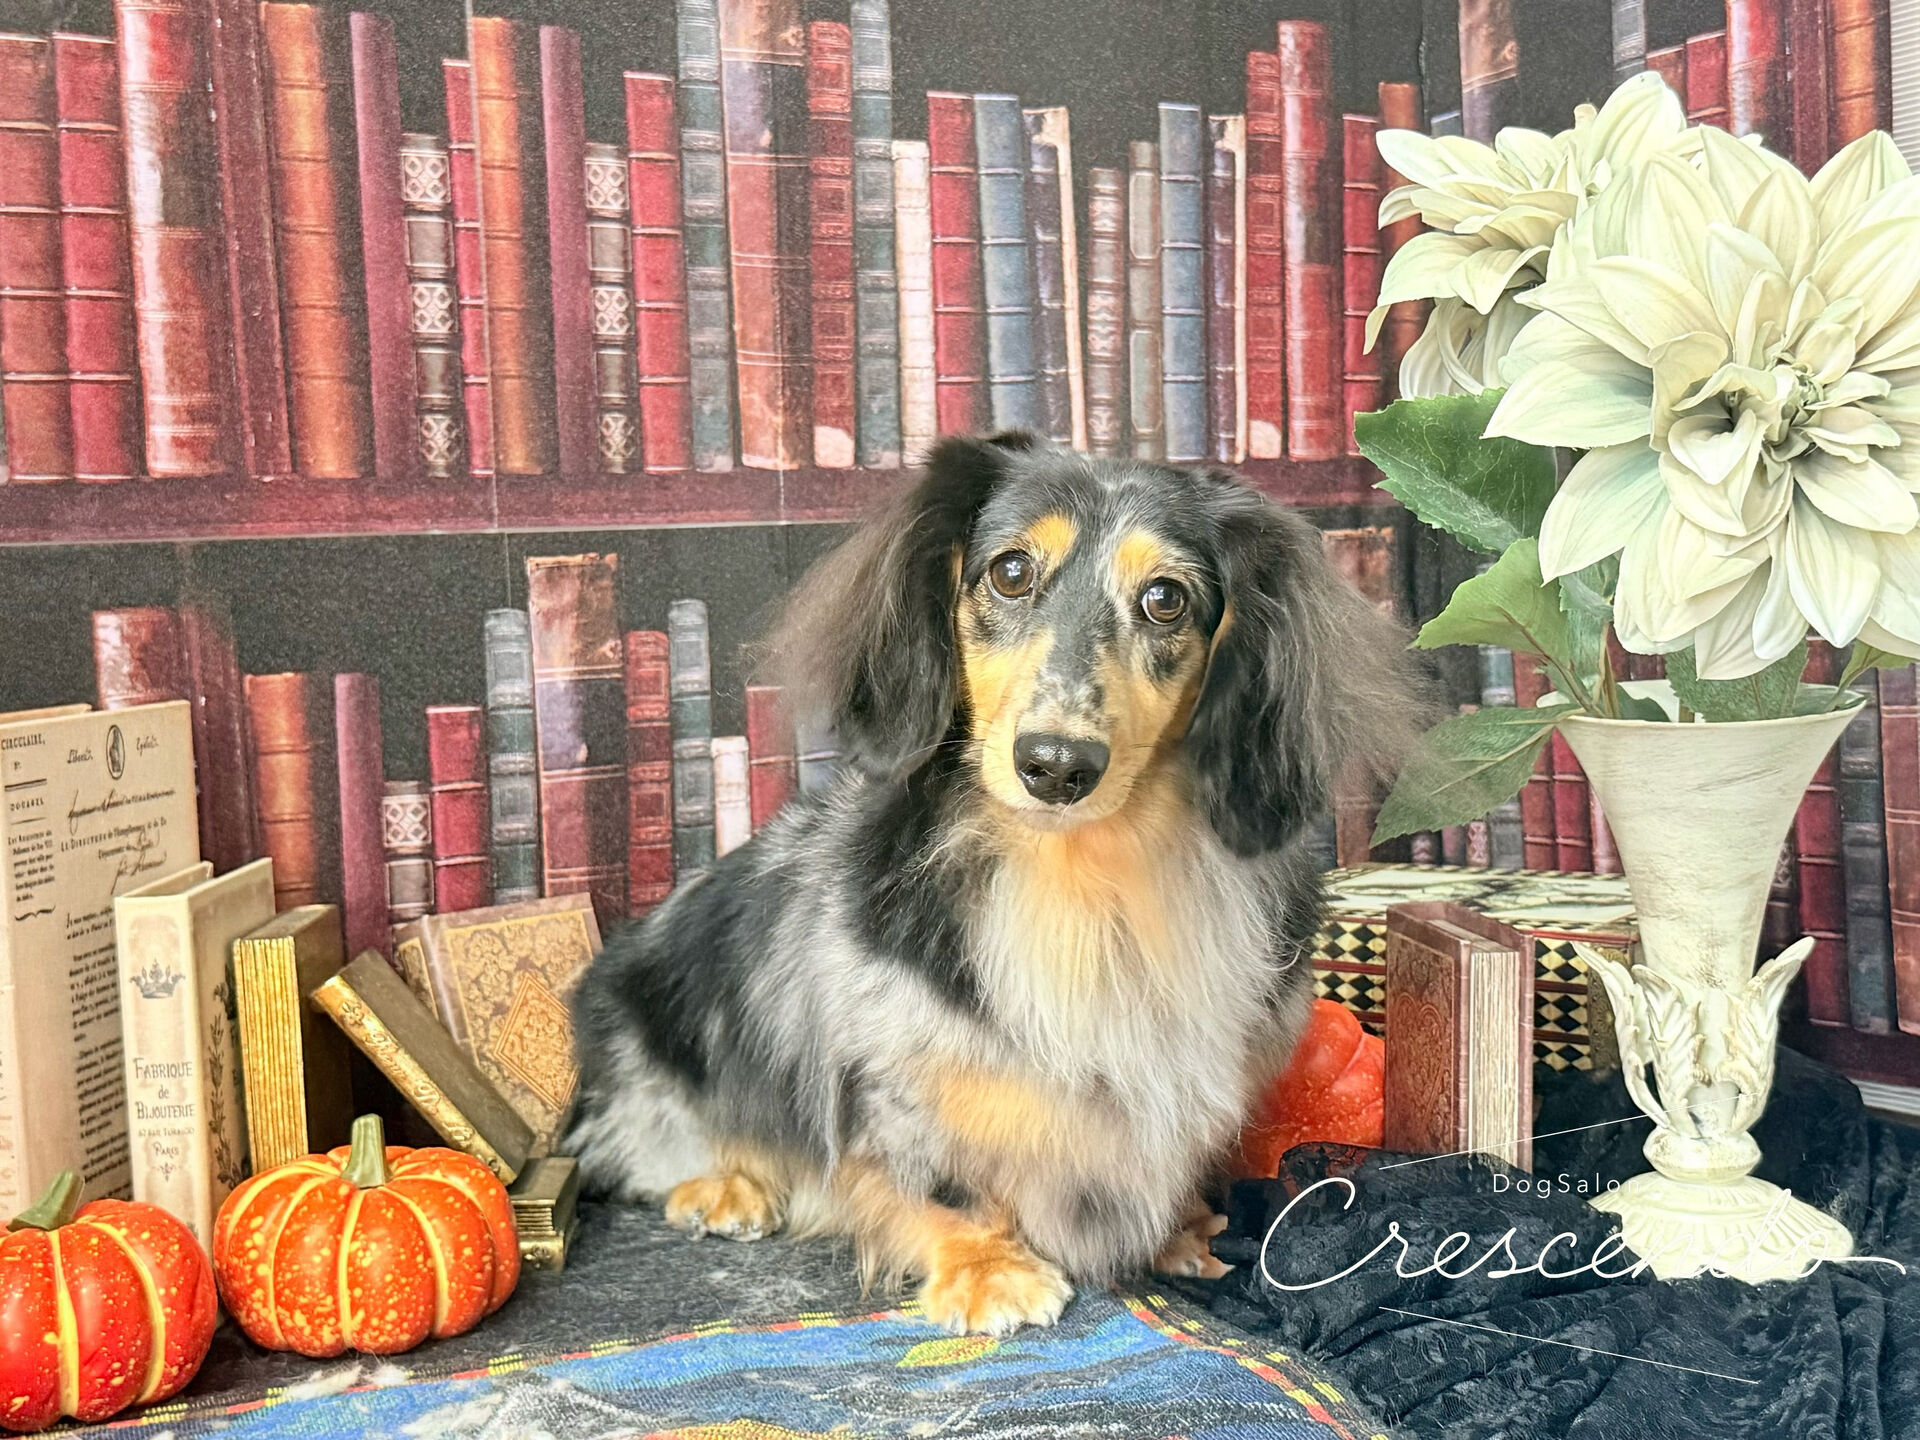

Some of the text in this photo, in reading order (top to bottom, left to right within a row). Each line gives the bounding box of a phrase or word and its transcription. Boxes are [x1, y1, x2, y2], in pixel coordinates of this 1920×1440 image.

[133, 1058, 193, 1079] FABRIQUE
[158, 1084, 169, 1099] de
[135, 1101, 196, 1120] BIJOUTERIE
